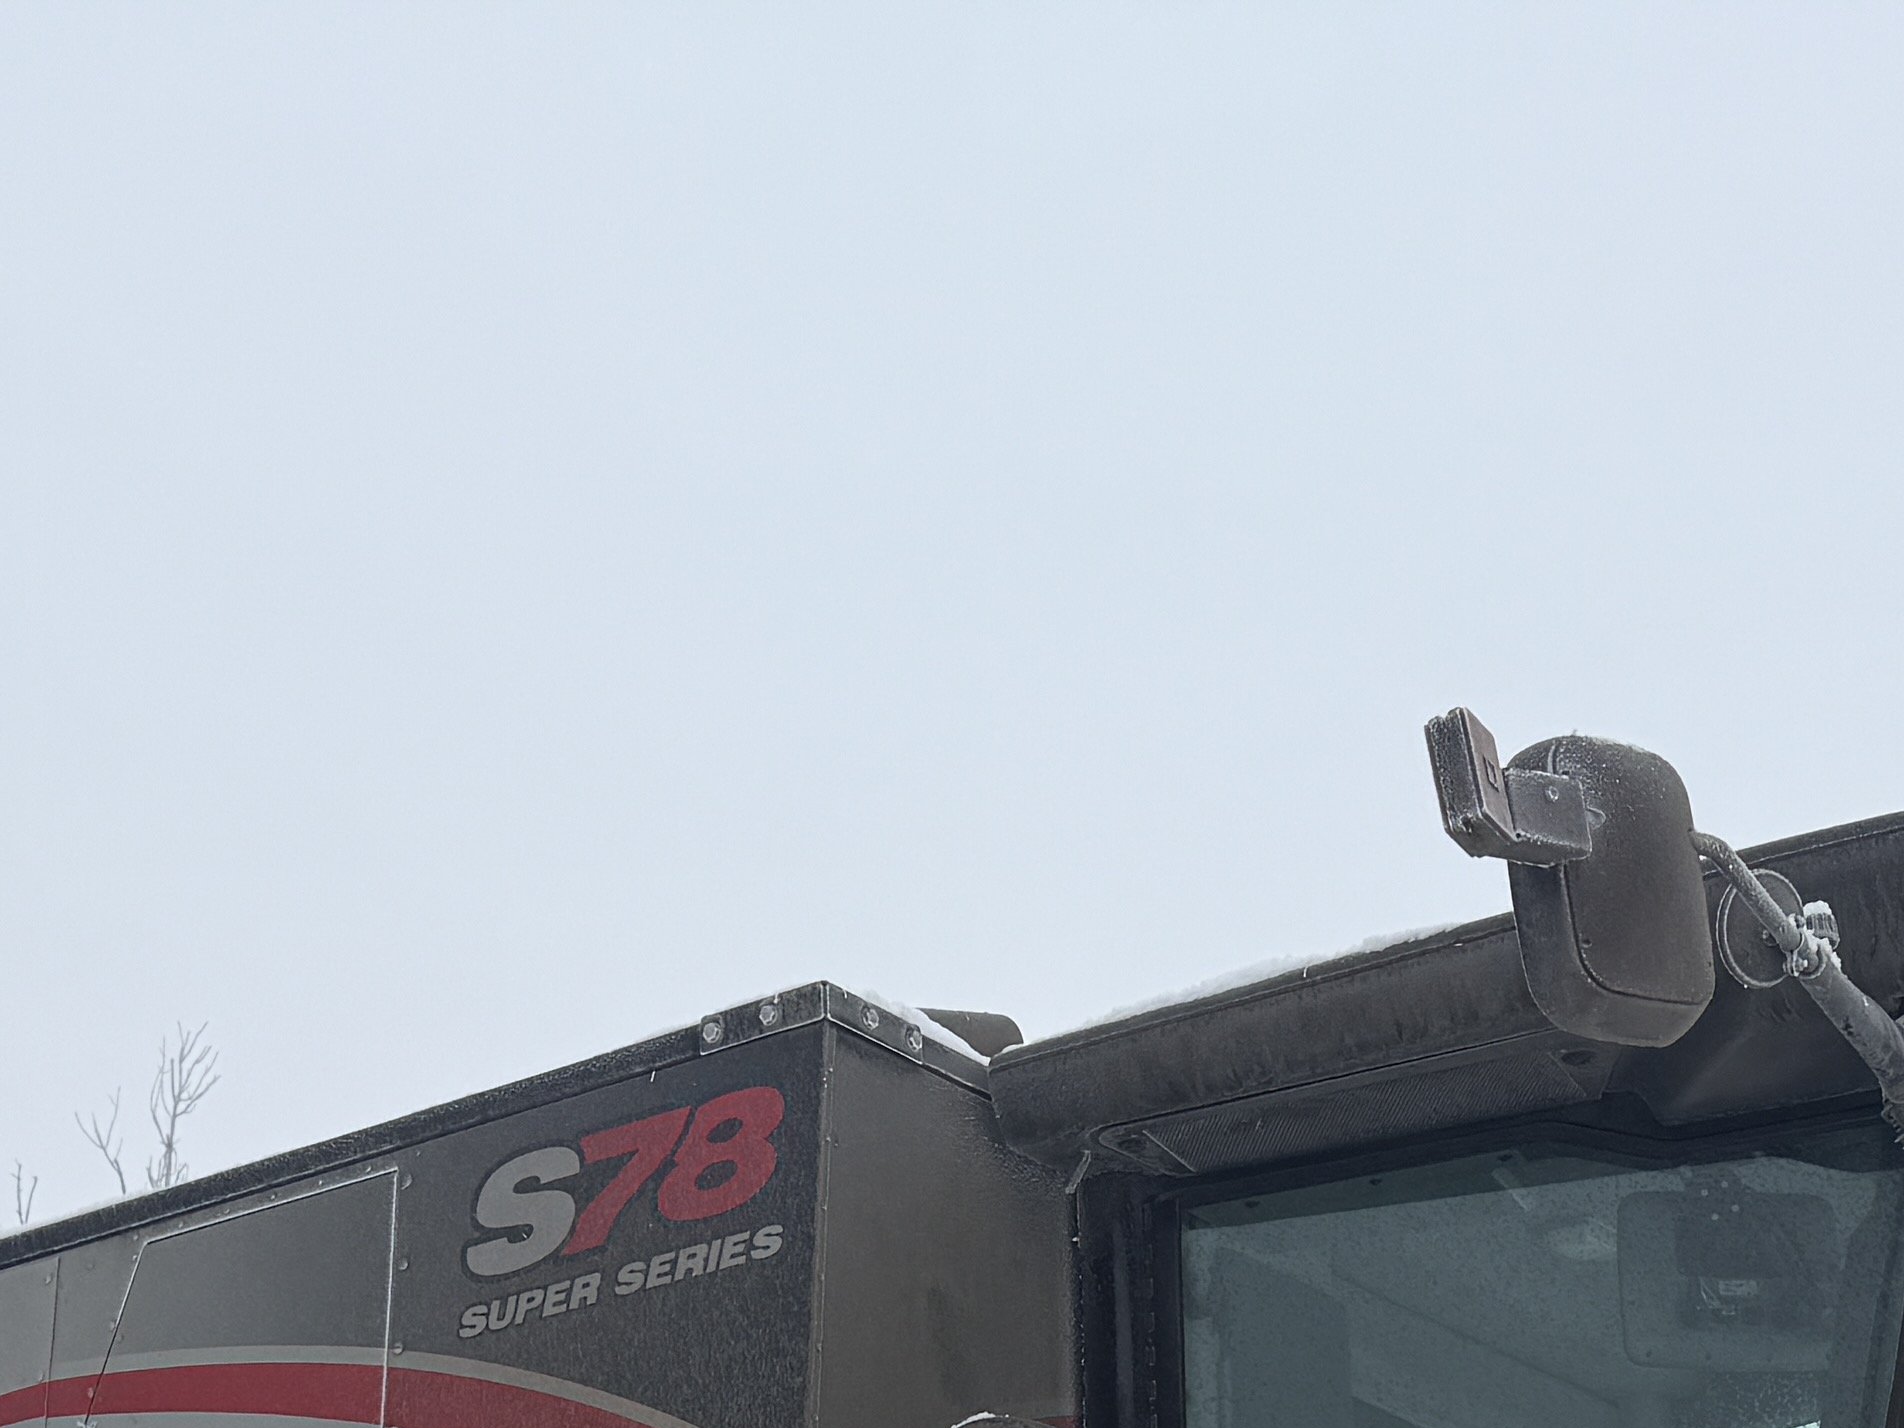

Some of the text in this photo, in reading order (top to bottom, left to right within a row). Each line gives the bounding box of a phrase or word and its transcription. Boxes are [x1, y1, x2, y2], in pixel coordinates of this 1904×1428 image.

[466, 1086, 784, 1276] S78
[458, 1224, 784, 1338] SUPER SERIES
